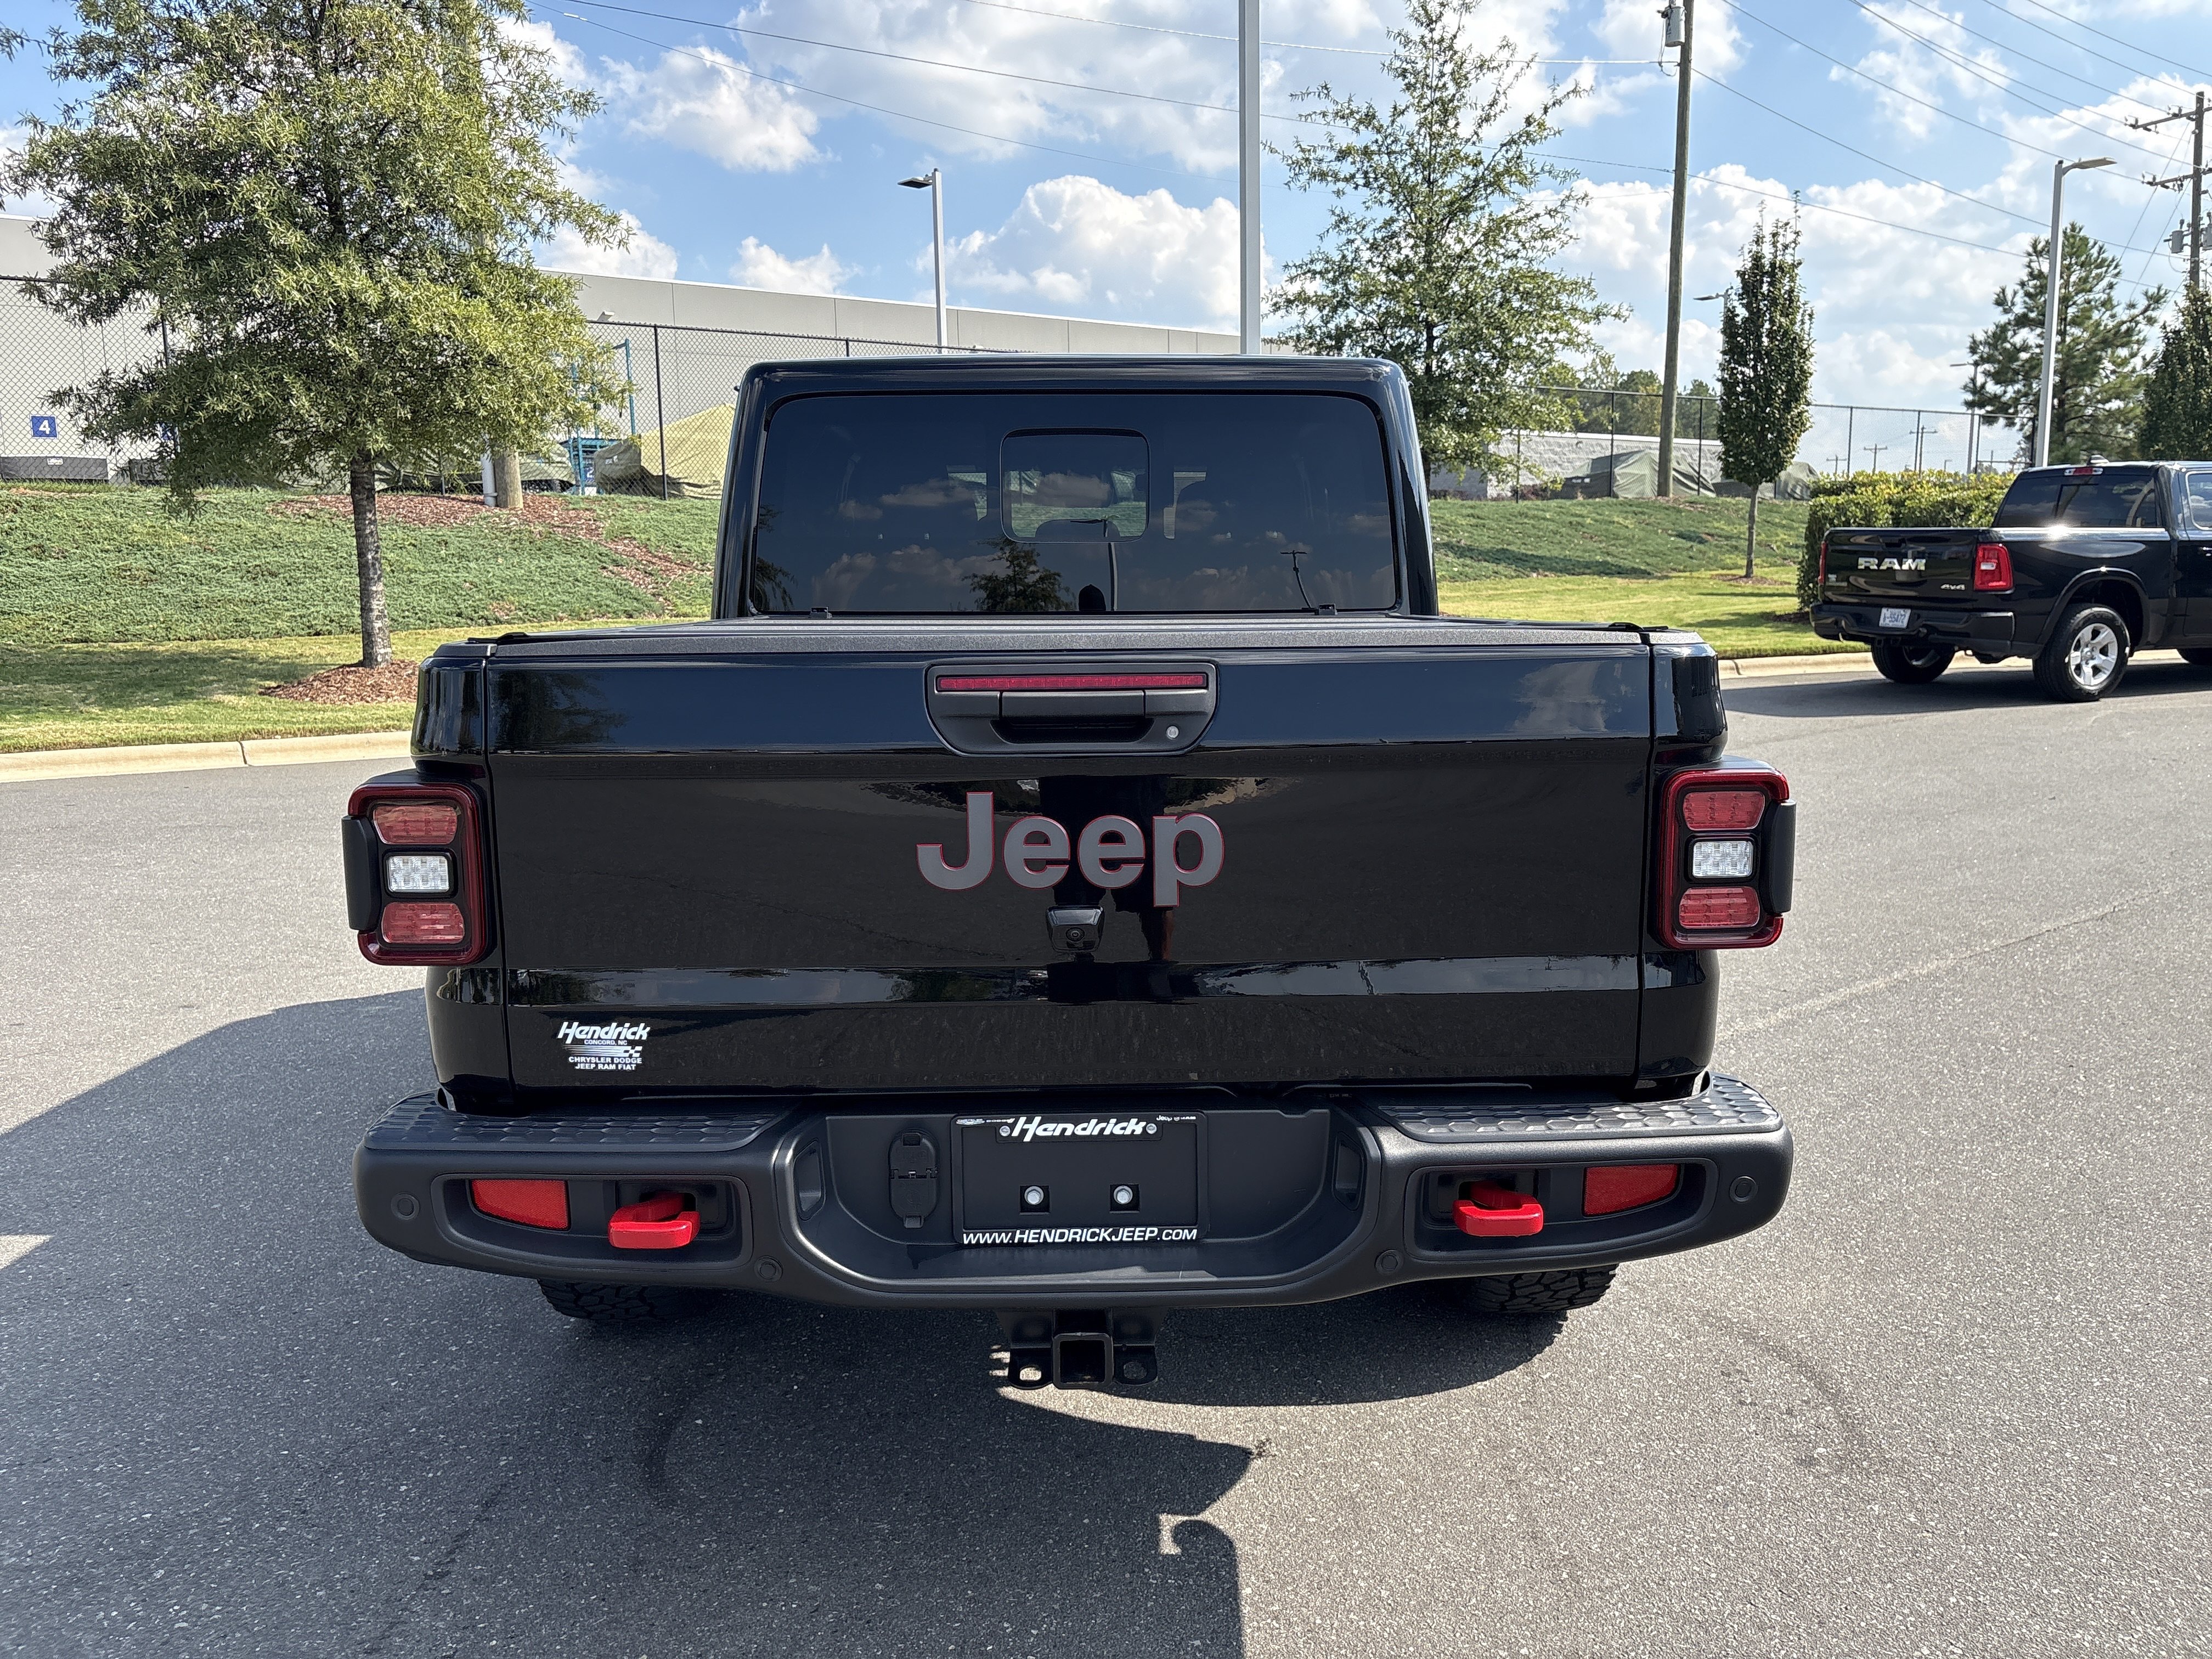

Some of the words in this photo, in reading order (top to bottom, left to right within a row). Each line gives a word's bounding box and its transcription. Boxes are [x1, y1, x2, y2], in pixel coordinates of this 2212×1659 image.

[38, 419, 50, 435] 4
[1858, 557, 1926, 571] RAM
[916, 792, 1225, 907] Jeep
[557, 1022, 651, 1044] Hendrick
[1011, 1116, 1147, 1142] Hendrick
[963, 1227, 1198, 1244] WWW.HENDRICKJEEP.COM
